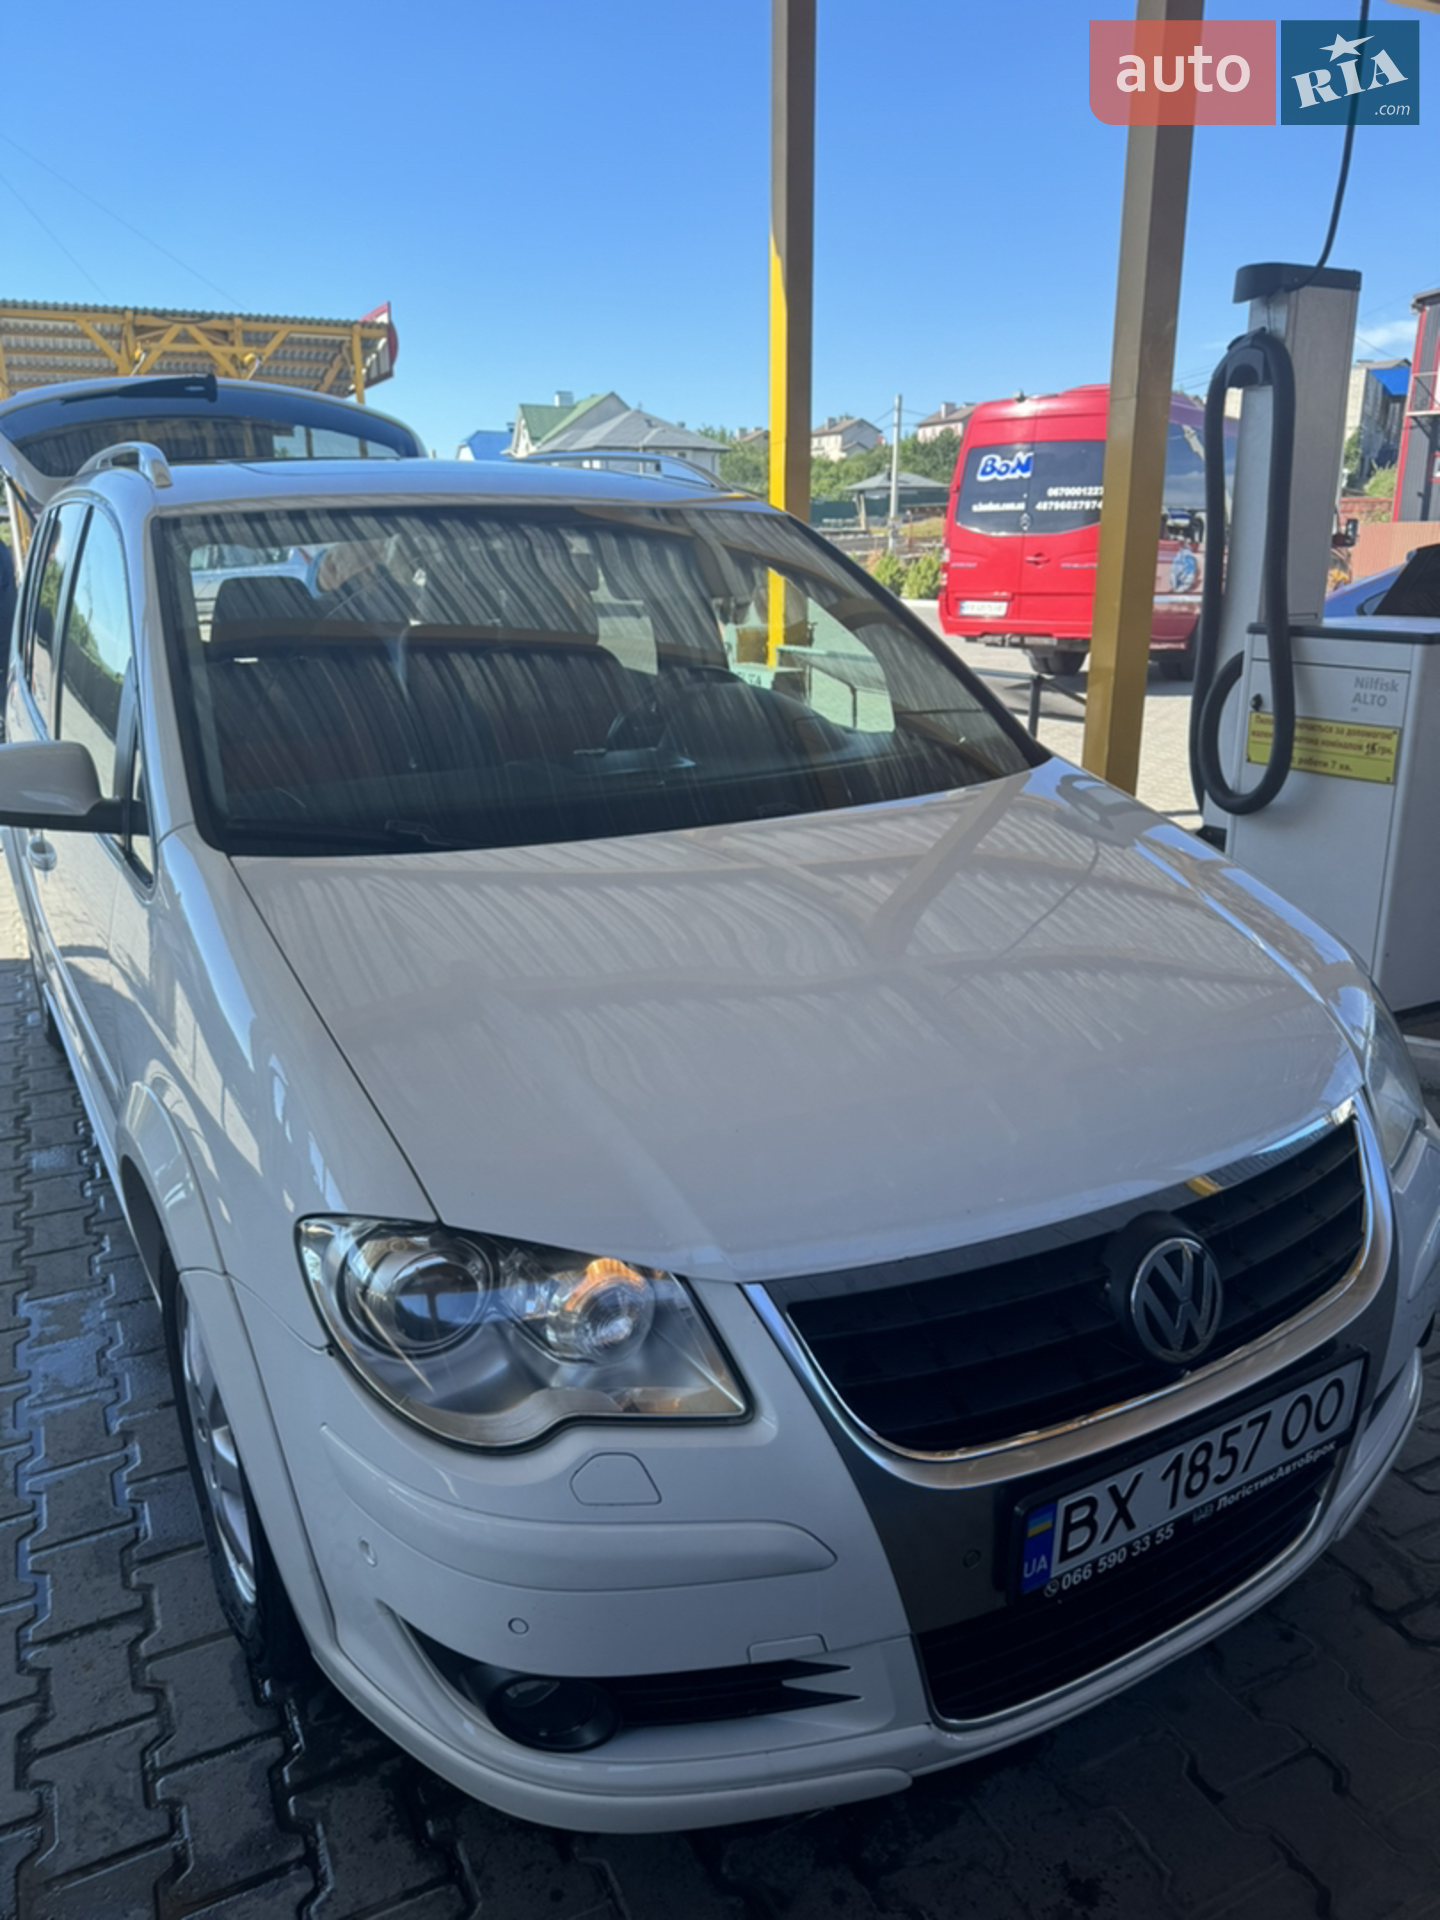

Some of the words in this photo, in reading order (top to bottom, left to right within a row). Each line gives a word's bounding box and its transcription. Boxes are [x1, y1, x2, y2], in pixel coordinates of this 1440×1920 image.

[1352, 692, 1388, 707] ALTO
[1353, 676, 1399, 693] Nilfisk
[1023, 1554, 1048, 1579] UA
[1057, 1471, 1144, 1565] BX
[1160, 1410, 1272, 1511] 1857
[1061, 1564, 1092, 1591] 066
[1097, 1548, 1127, 1573] 590
[1131, 1535, 1151, 1557] 33
[1155, 1523, 1175, 1545] 55
